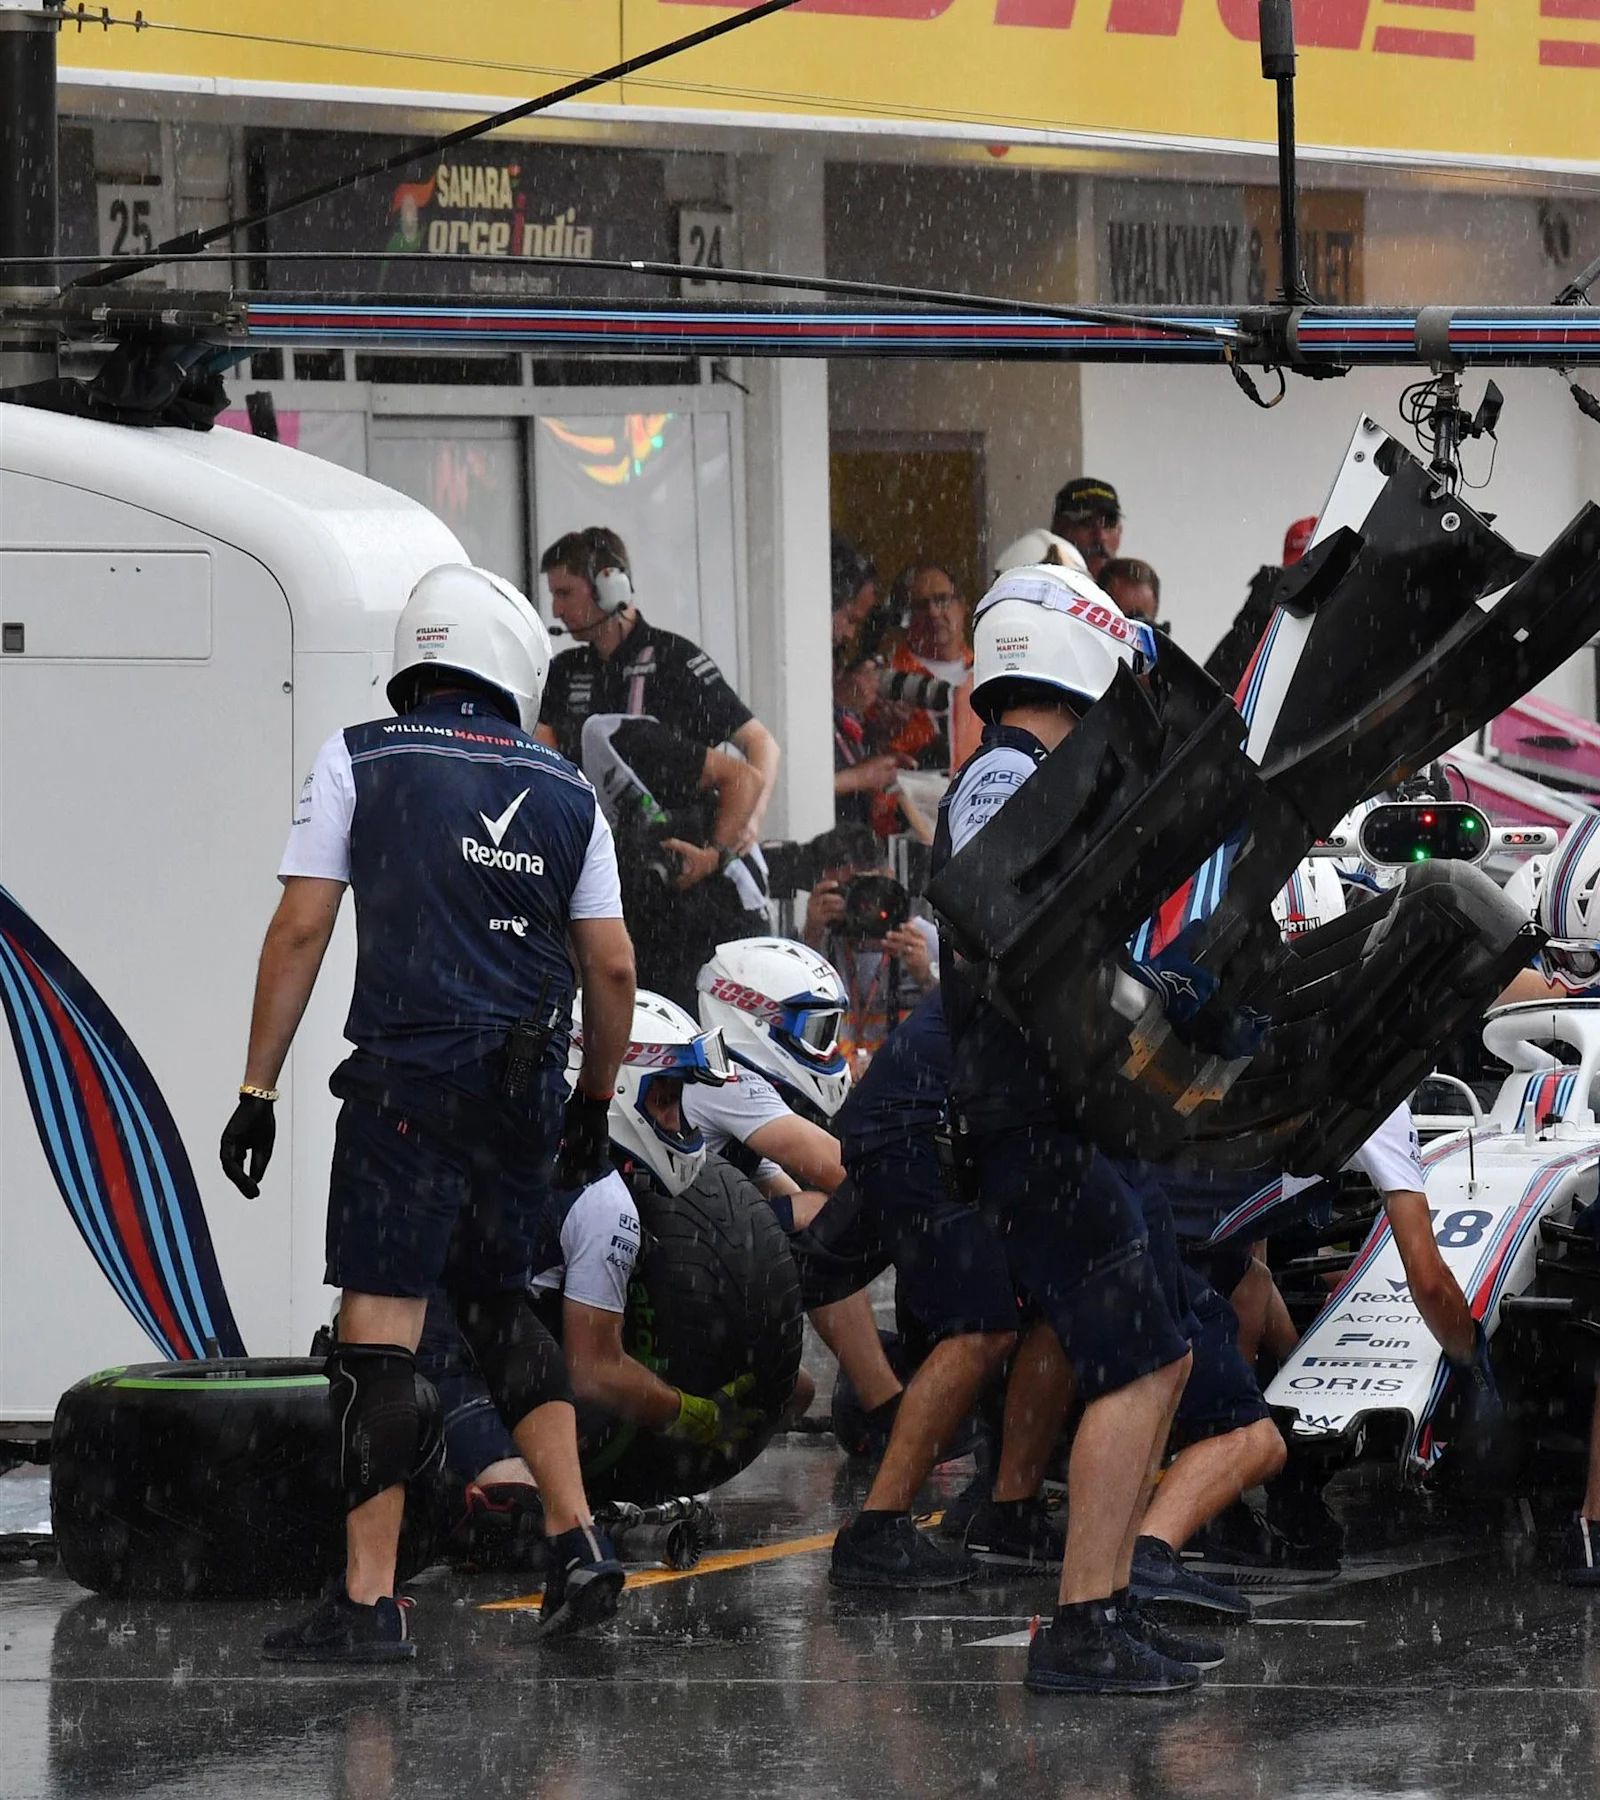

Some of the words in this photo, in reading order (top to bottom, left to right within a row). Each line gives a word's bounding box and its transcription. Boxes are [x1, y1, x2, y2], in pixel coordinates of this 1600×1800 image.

[437, 164, 513, 210] SAHARA
[110, 199, 152, 256] 25
[690, 225, 724, 286] 24
[1107, 221, 1238, 304] WALKWAY
[1066, 597, 1143, 649] 100%
[416, 634, 448, 642] MARTINI
[995, 636, 1029, 644] WILLIAMS
[996, 643, 1028, 652] MARTINI
[383, 725, 454, 738] WILLIAMS
[454, 730, 515, 747] MARTINI
[516, 740, 562, 761] RACING
[462, 836, 544, 876] Rexona
[489, 918, 512, 931] BT
[1279, 917, 1320, 933] MARTINI
[710, 978, 784, 1025] 100%
[1350, 1292, 1414, 1303] Rexo
[1331, 1313, 1424, 1324] Acron
[1302, 1357, 1418, 1370] PIRELLI
[1289, 1376, 1403, 1392] ORIS
